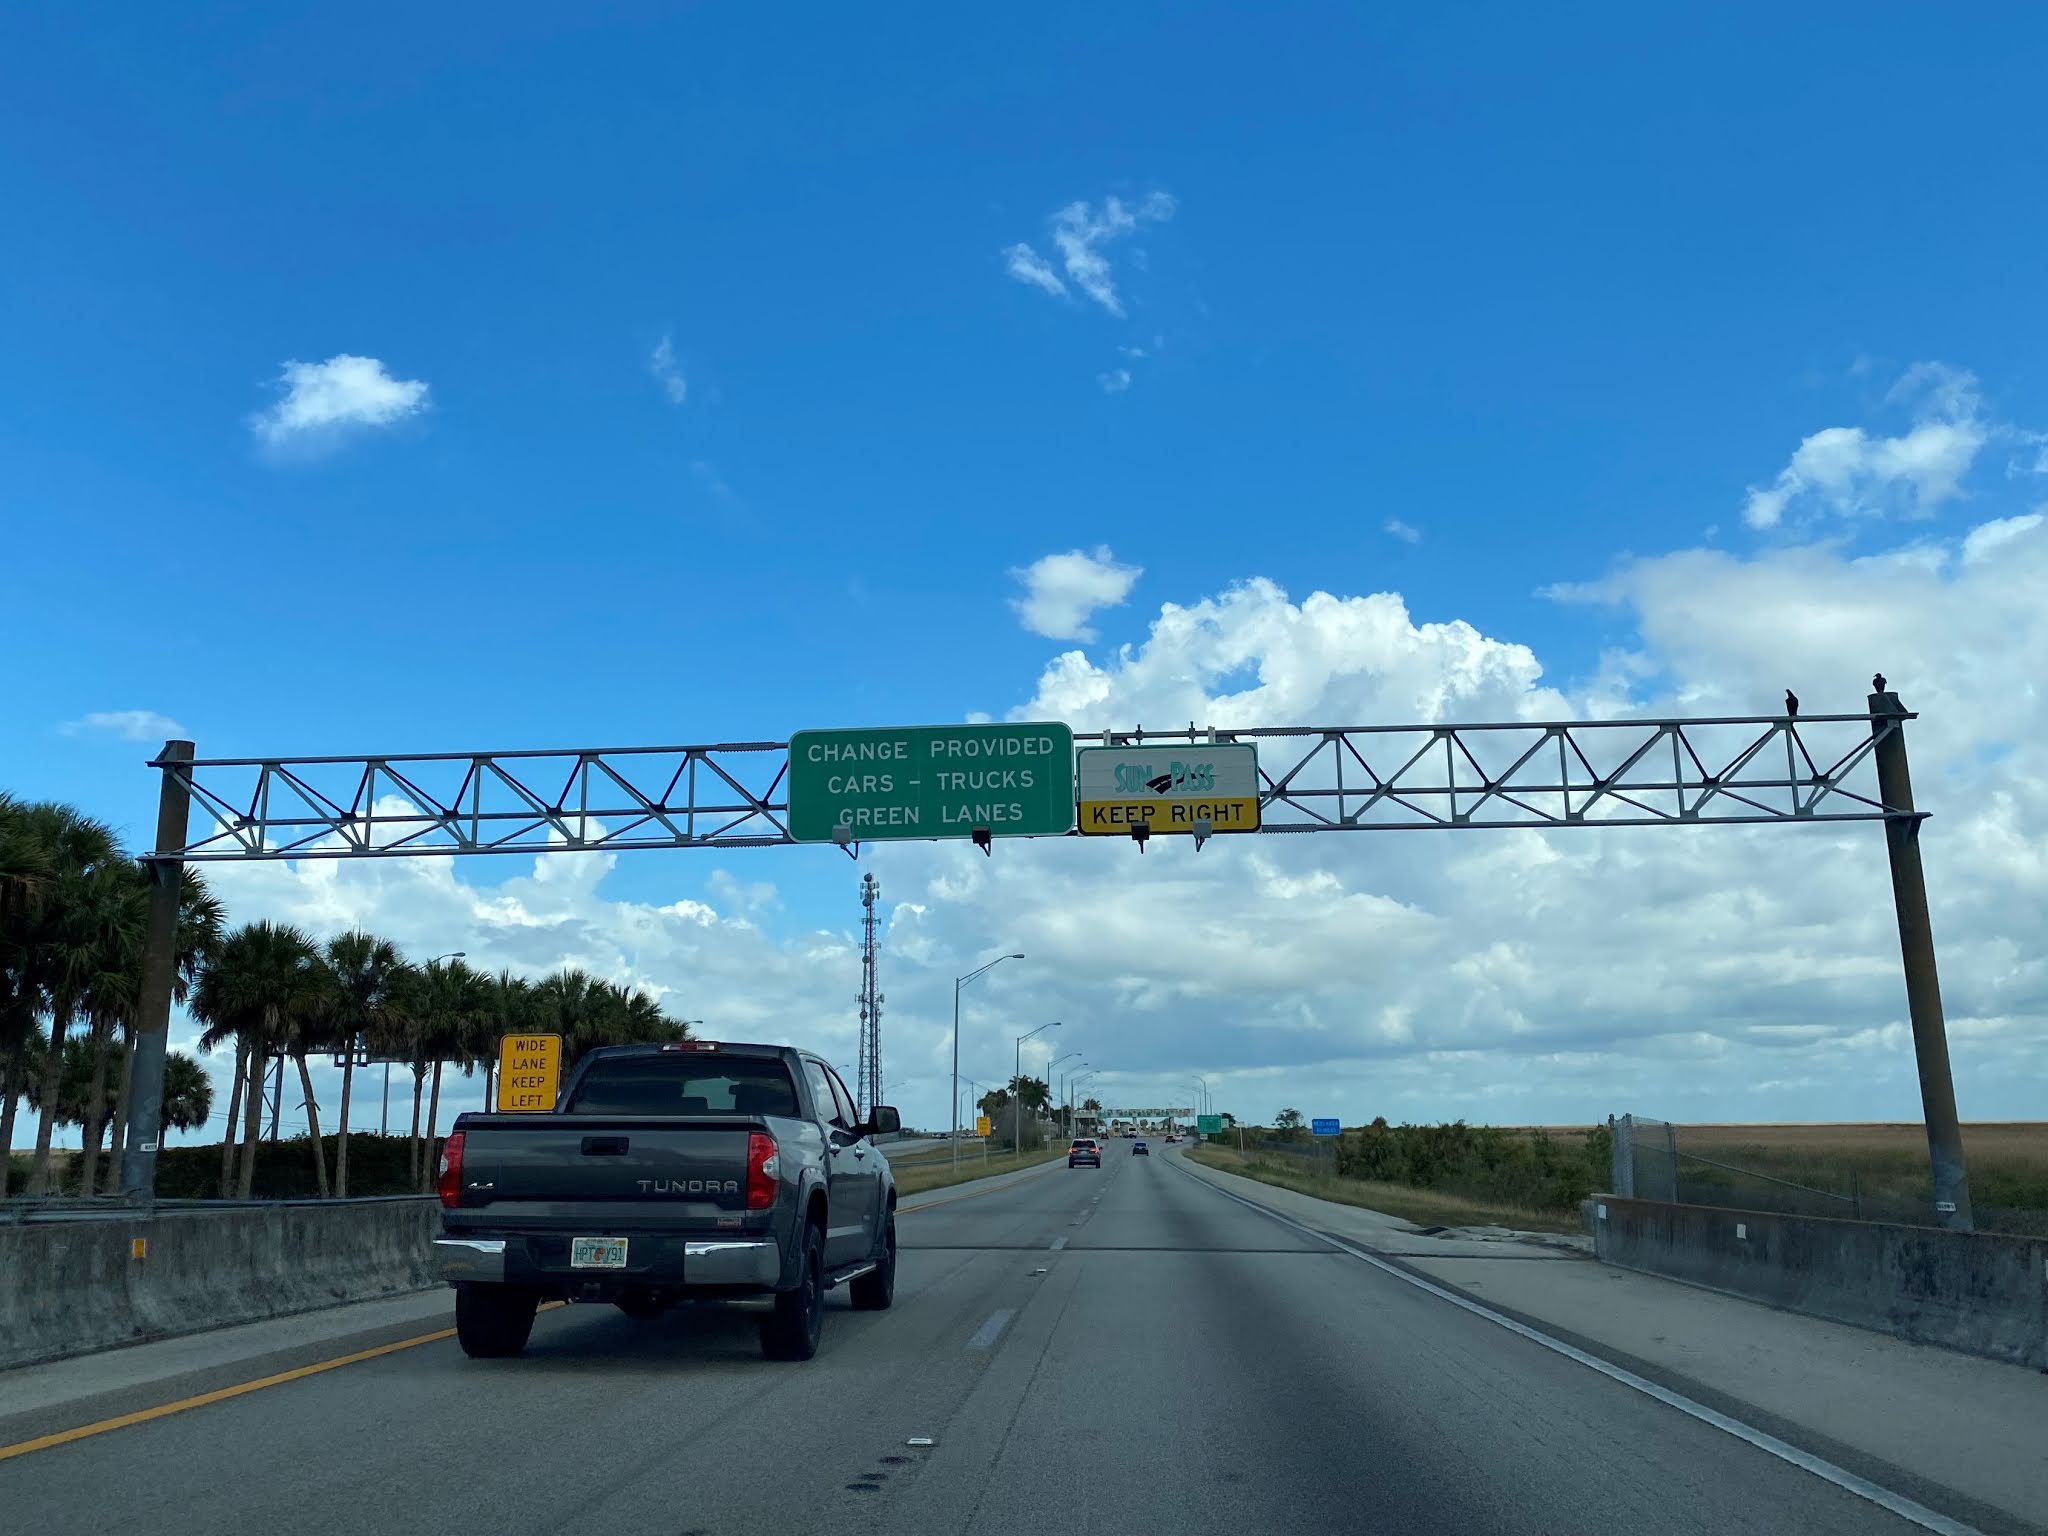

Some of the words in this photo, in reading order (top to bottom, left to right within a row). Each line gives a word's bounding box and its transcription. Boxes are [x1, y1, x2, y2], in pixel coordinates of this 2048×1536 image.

[807, 741, 908, 762] CHANGE
[931, 737, 1054, 758] PROVIDED
[828, 774, 894, 794] CARS
[936, 770, 1034, 790] TRUCKS
[1114, 762, 1153, 793] SUN
[1170, 761, 1217, 792] PASS
[839, 806, 920, 826] GREEN
[942, 803, 1023, 823] LANES
[1093, 805, 1156, 824] KEEP
[1171, 804, 1244, 823] RIGHT
[515, 1040, 546, 1052] WIDE
[513, 1058, 546, 1070] LANE
[512, 1076, 545, 1088] KEEP
[511, 1094, 543, 1107] LEFT
[636, 1180, 738, 1193] TUNDRA
